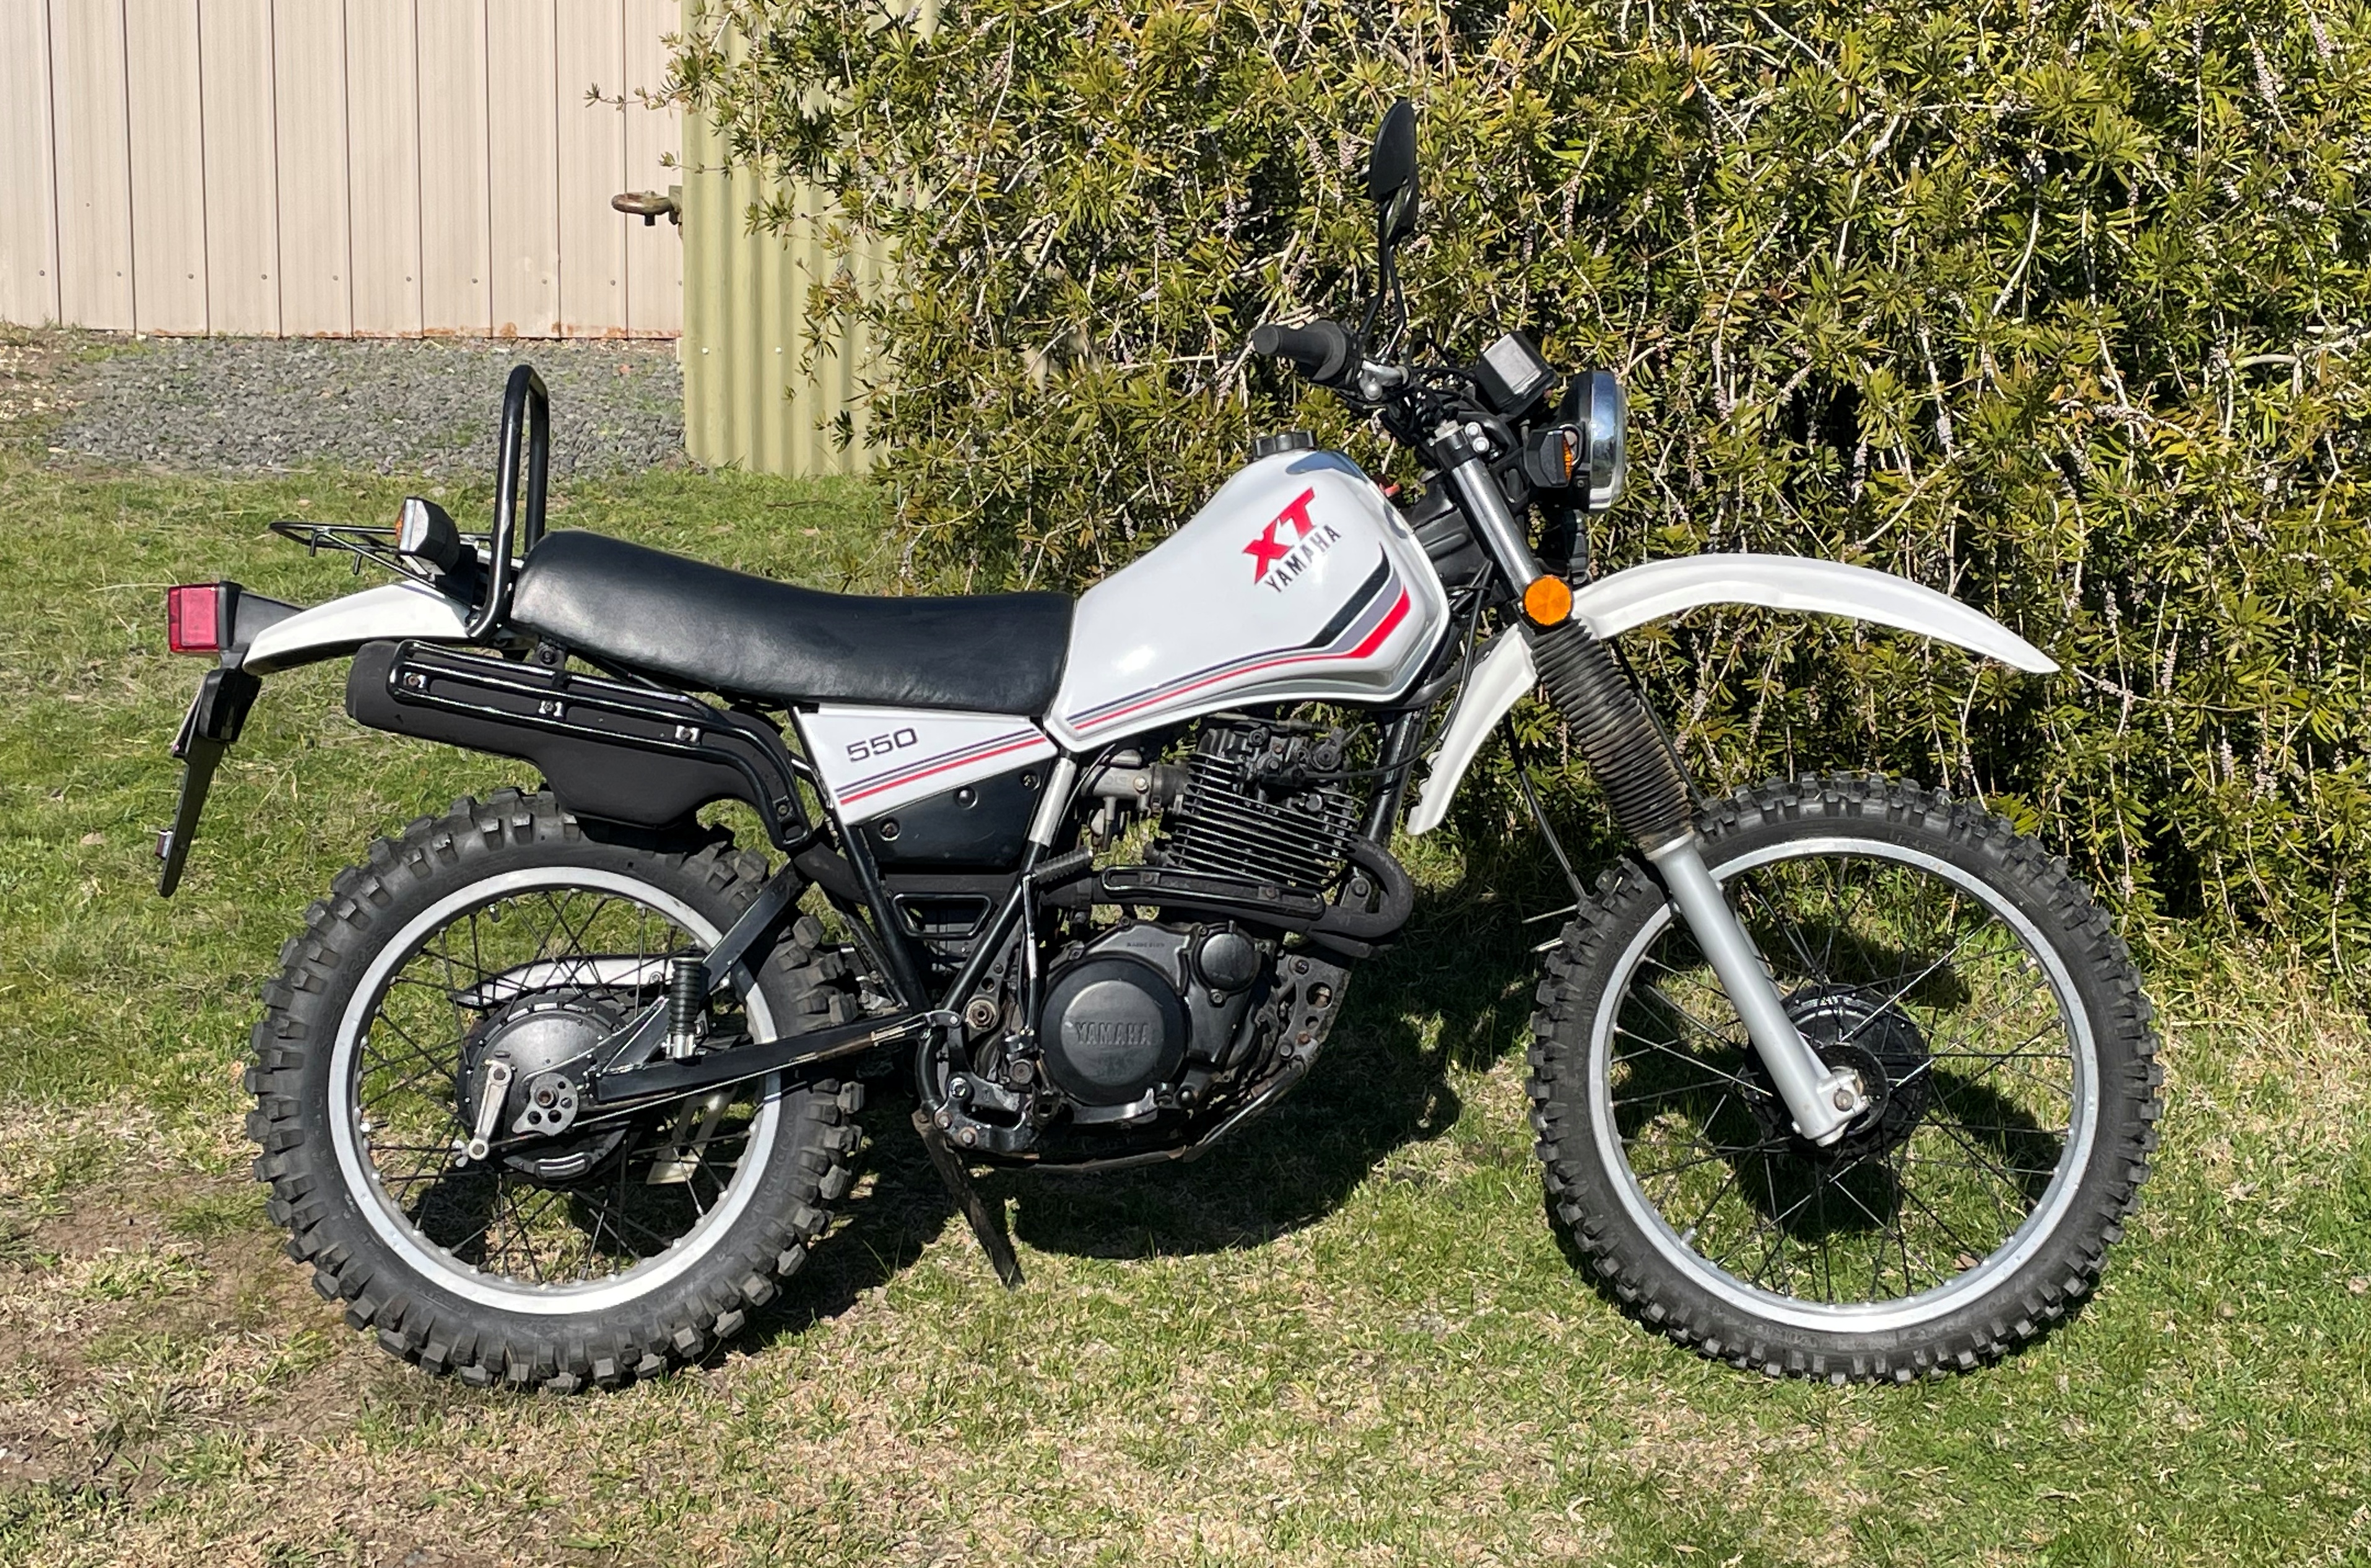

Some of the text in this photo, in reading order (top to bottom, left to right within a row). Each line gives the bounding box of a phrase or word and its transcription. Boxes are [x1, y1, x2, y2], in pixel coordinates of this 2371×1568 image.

[1242, 487, 1315, 585] XT
[1264, 524, 1342, 593] YAMAHA
[846, 727, 918, 763] 550
[1075, 1021, 1151, 1046] YAMAHA
